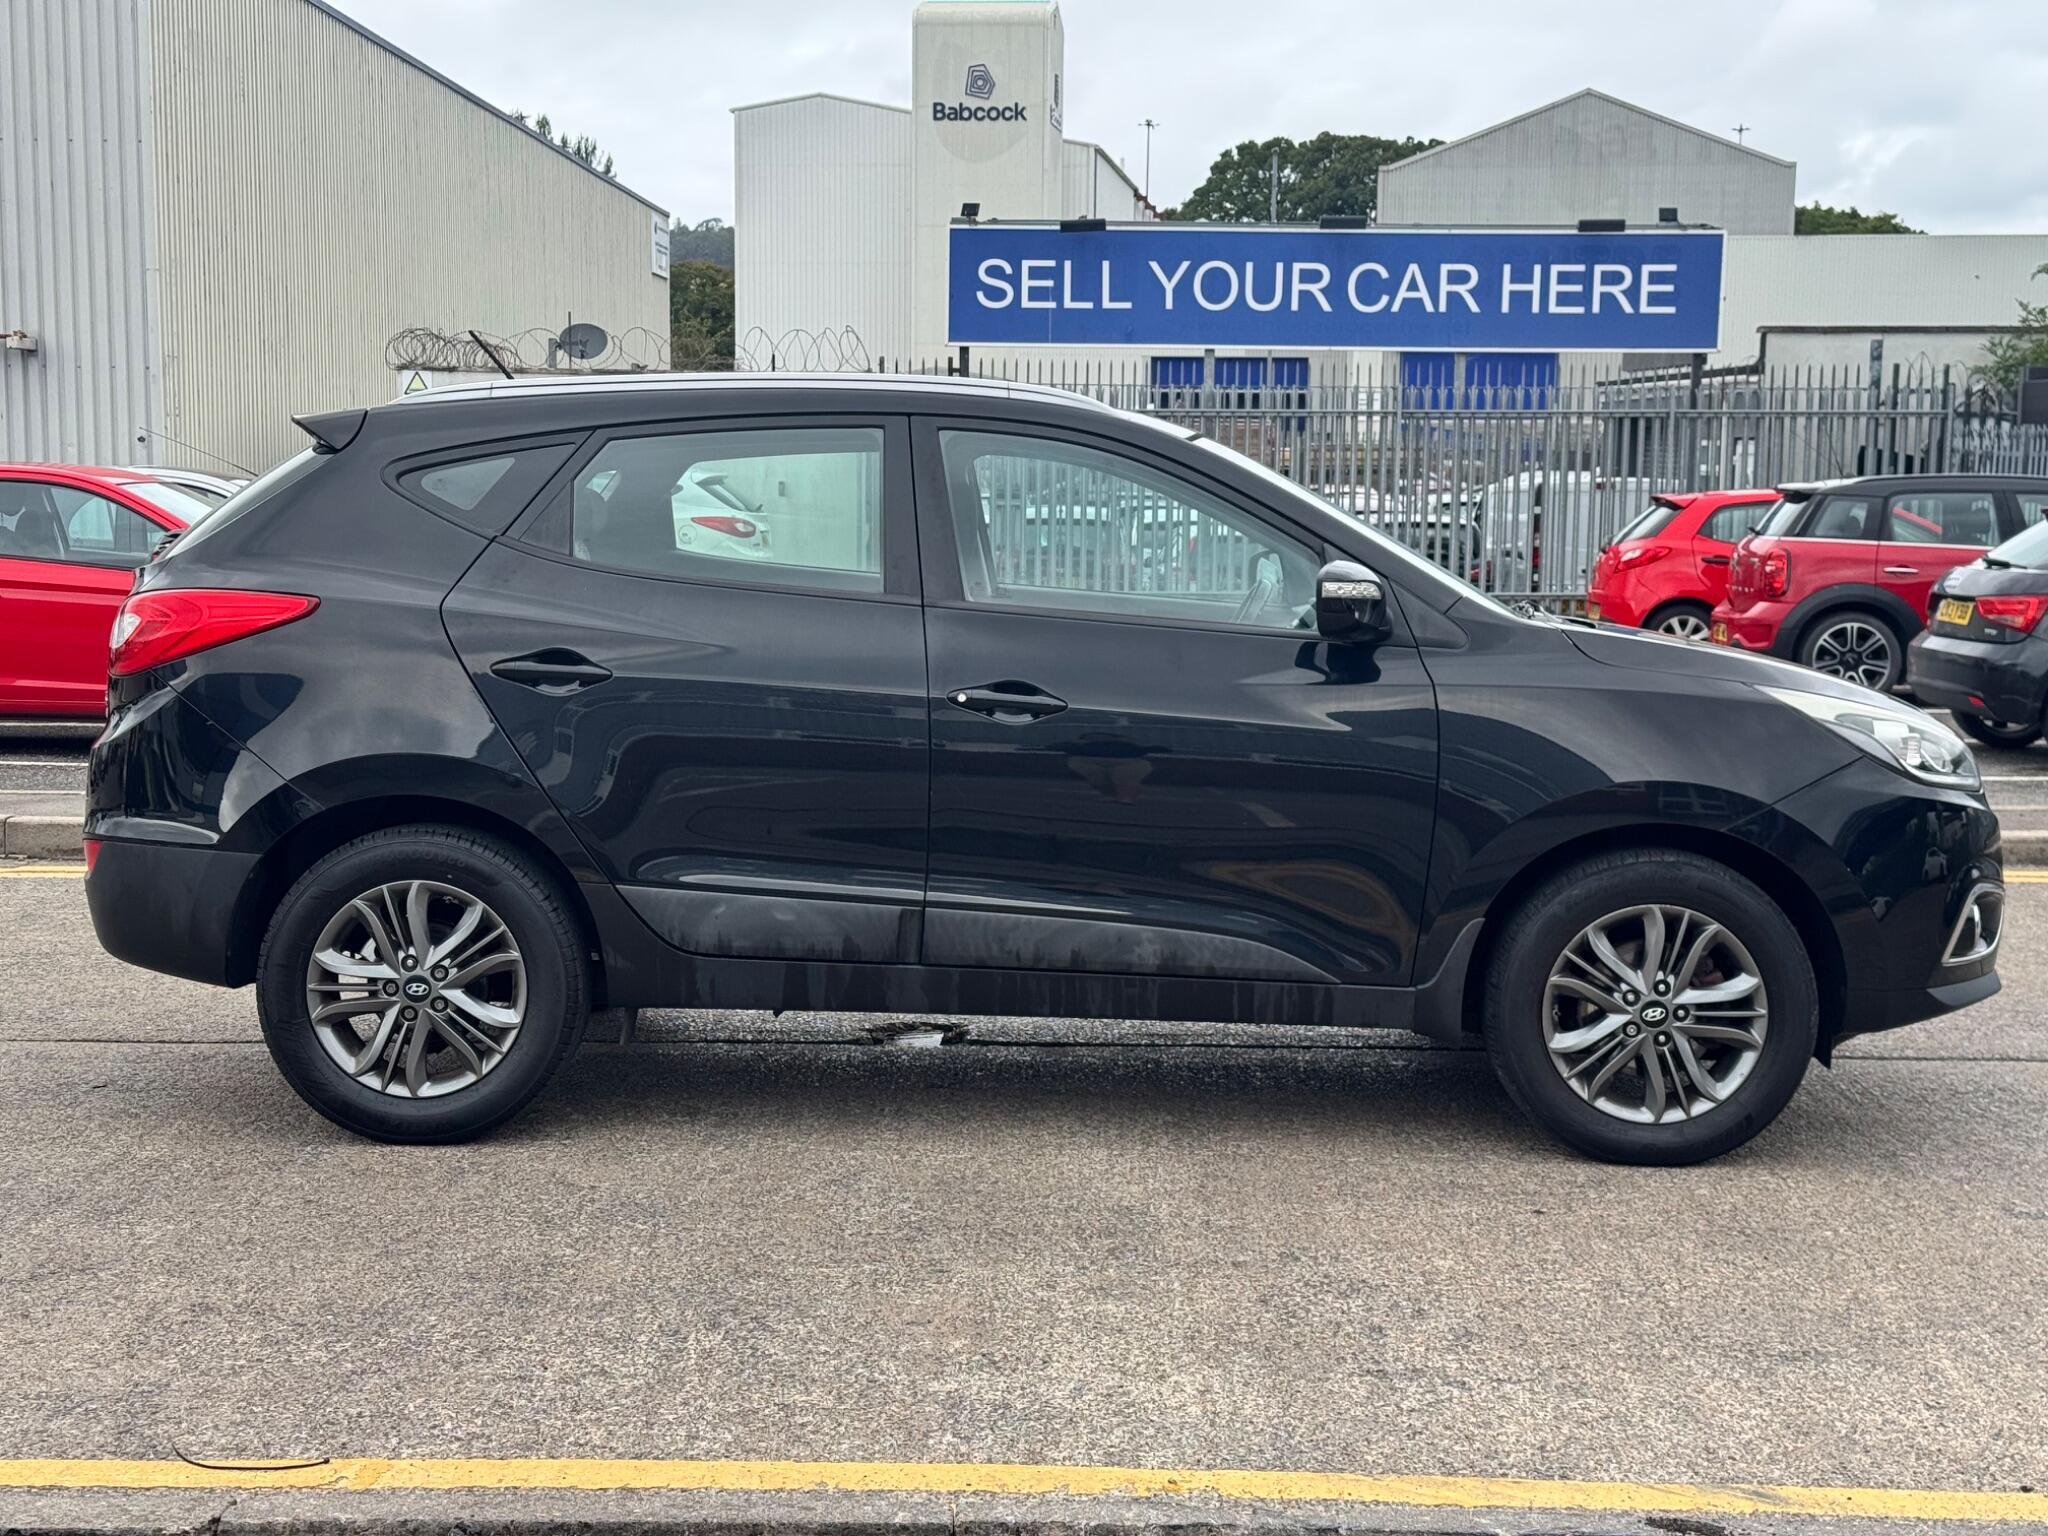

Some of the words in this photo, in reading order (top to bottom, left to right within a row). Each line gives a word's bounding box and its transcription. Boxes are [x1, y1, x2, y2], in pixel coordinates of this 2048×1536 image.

[932, 101, 1027, 122] Babcock
[976, 258, 1133, 309] SELL
[1148, 260, 1332, 312] YOUR
[1347, 262, 1481, 314] CAR
[1501, 263, 1678, 315] HERE
